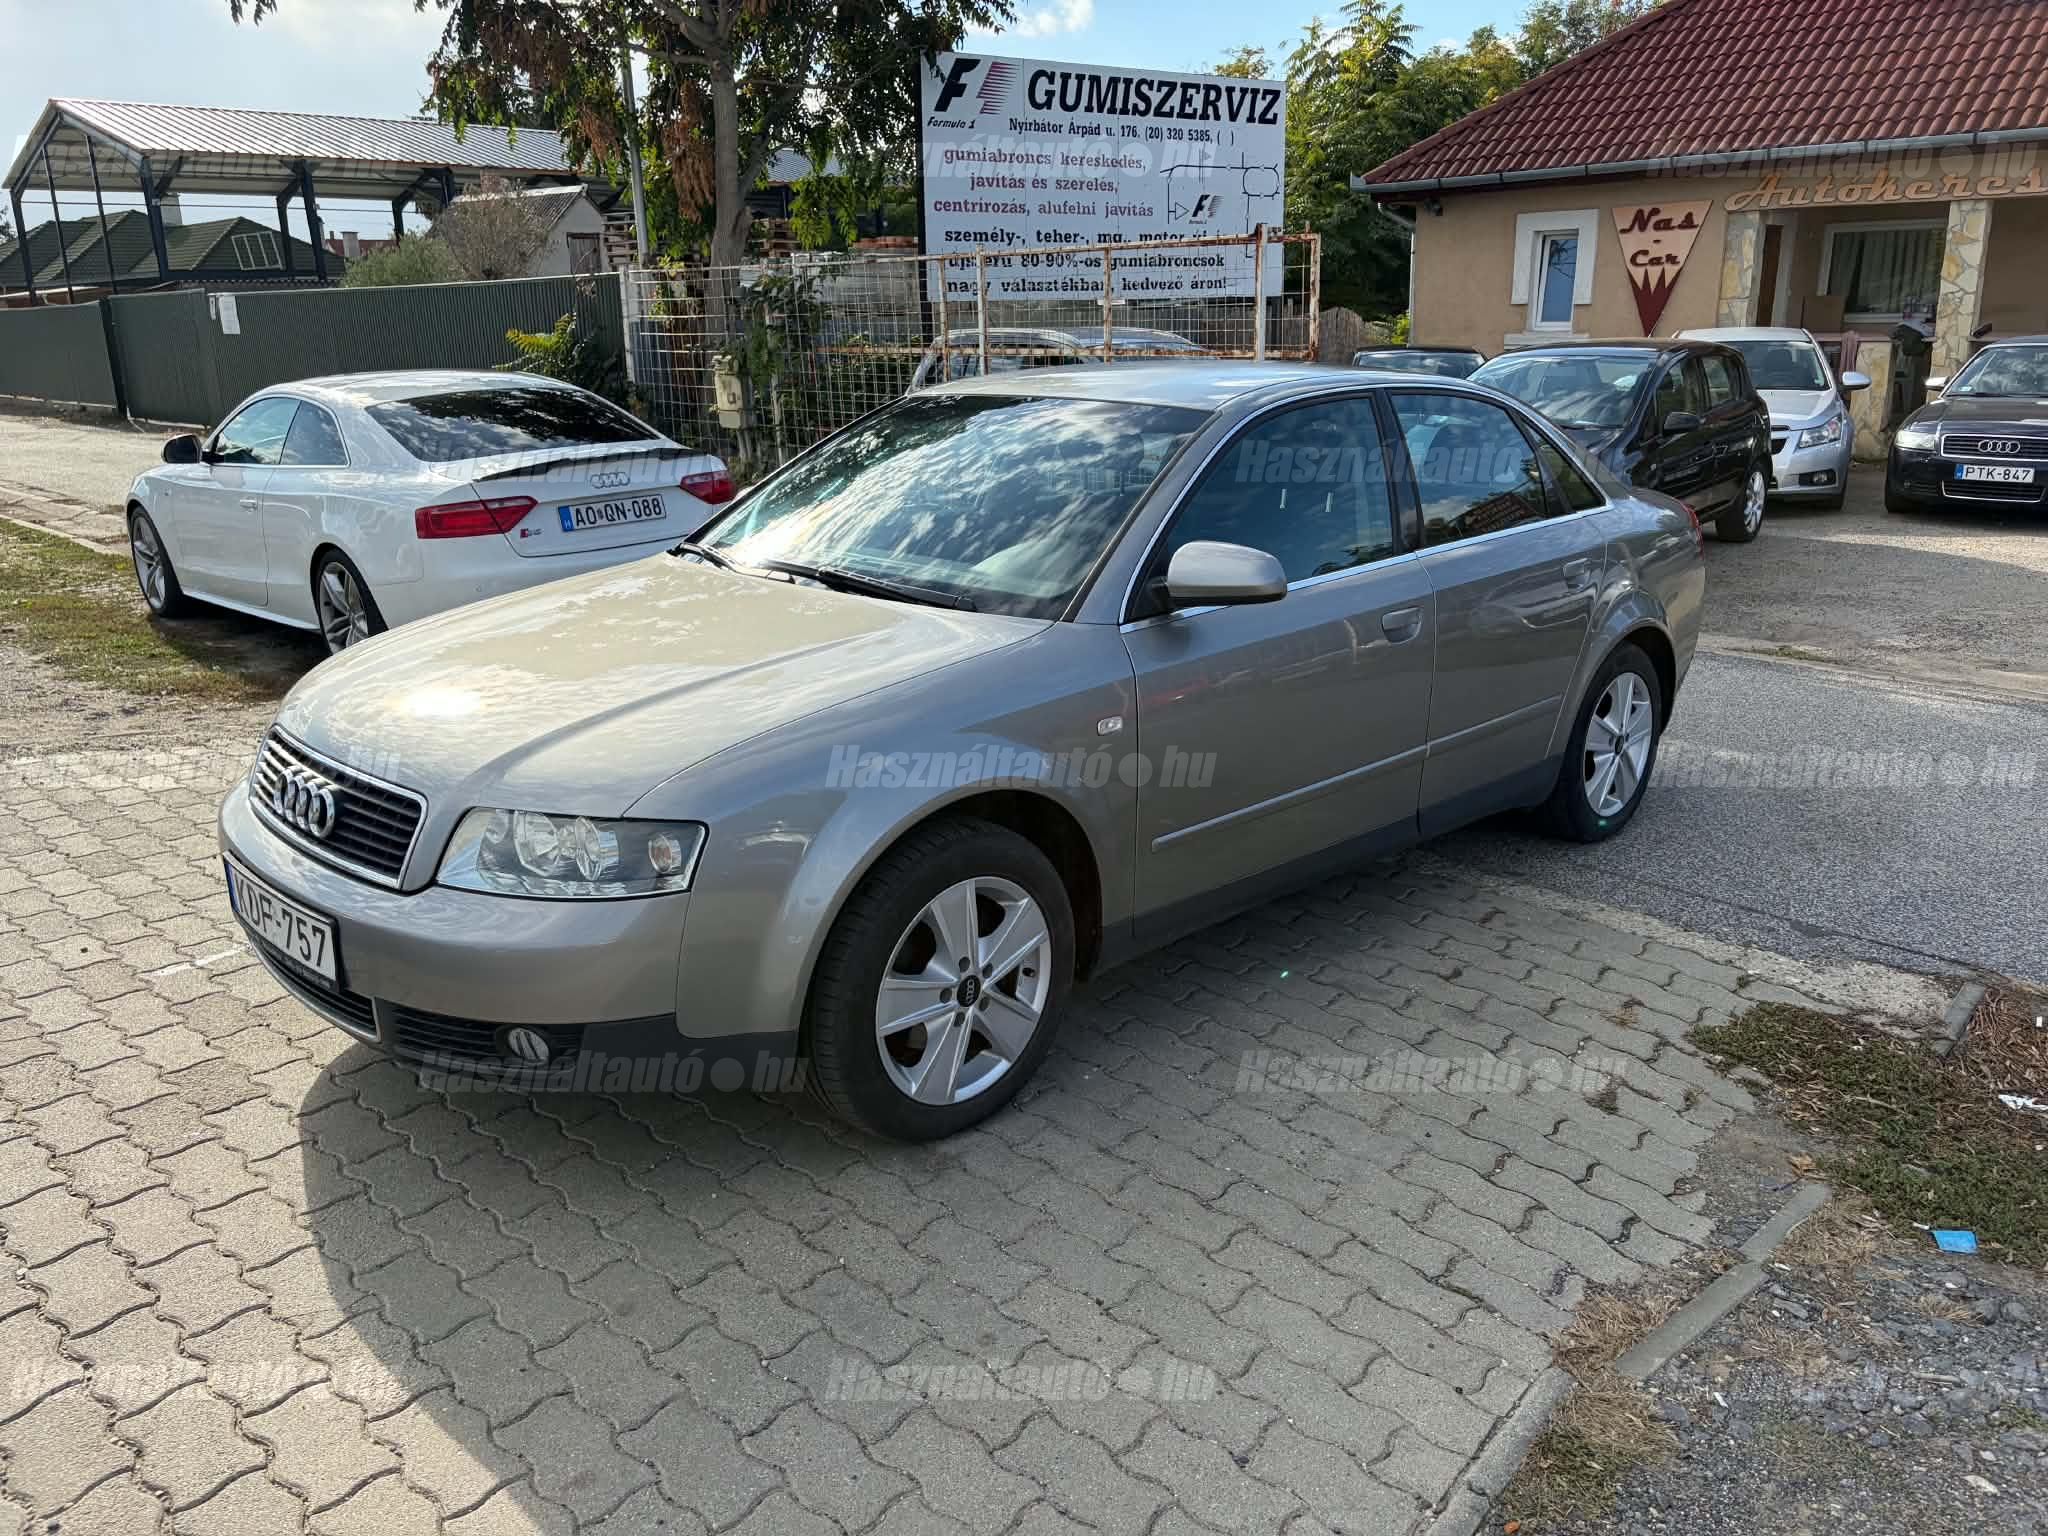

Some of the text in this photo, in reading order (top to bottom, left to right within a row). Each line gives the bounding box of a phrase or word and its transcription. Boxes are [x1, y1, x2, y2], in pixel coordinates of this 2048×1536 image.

[1027, 69, 1281, 125] GUMISZERVIZ
[927, 116, 966, 129] Formula
[1068, 116, 1101, 138] Árpád
[1105, 127, 1116, 137] u.
[1144, 126, 1163, 142] (20)
[1166, 127, 1184, 141] 320
[944, 147, 1147, 171] gumiabroncs kereskedés,
[1031, 174, 1048, 189] és
[1055, 177, 1119, 195] szerelés,
[1038, 199, 1097, 216] alufelni
[1619, 207, 1700, 234] Nas
[944, 227, 1026, 246] személy-,
[1036, 229, 1090, 244] teher-,
[1630, 249, 1681, 267] Car
[1121, 275, 1183, 291] kedvező
[1965, 466, 2031, 481] PTK-847
[234, 873, 326, 968] KDF-757
